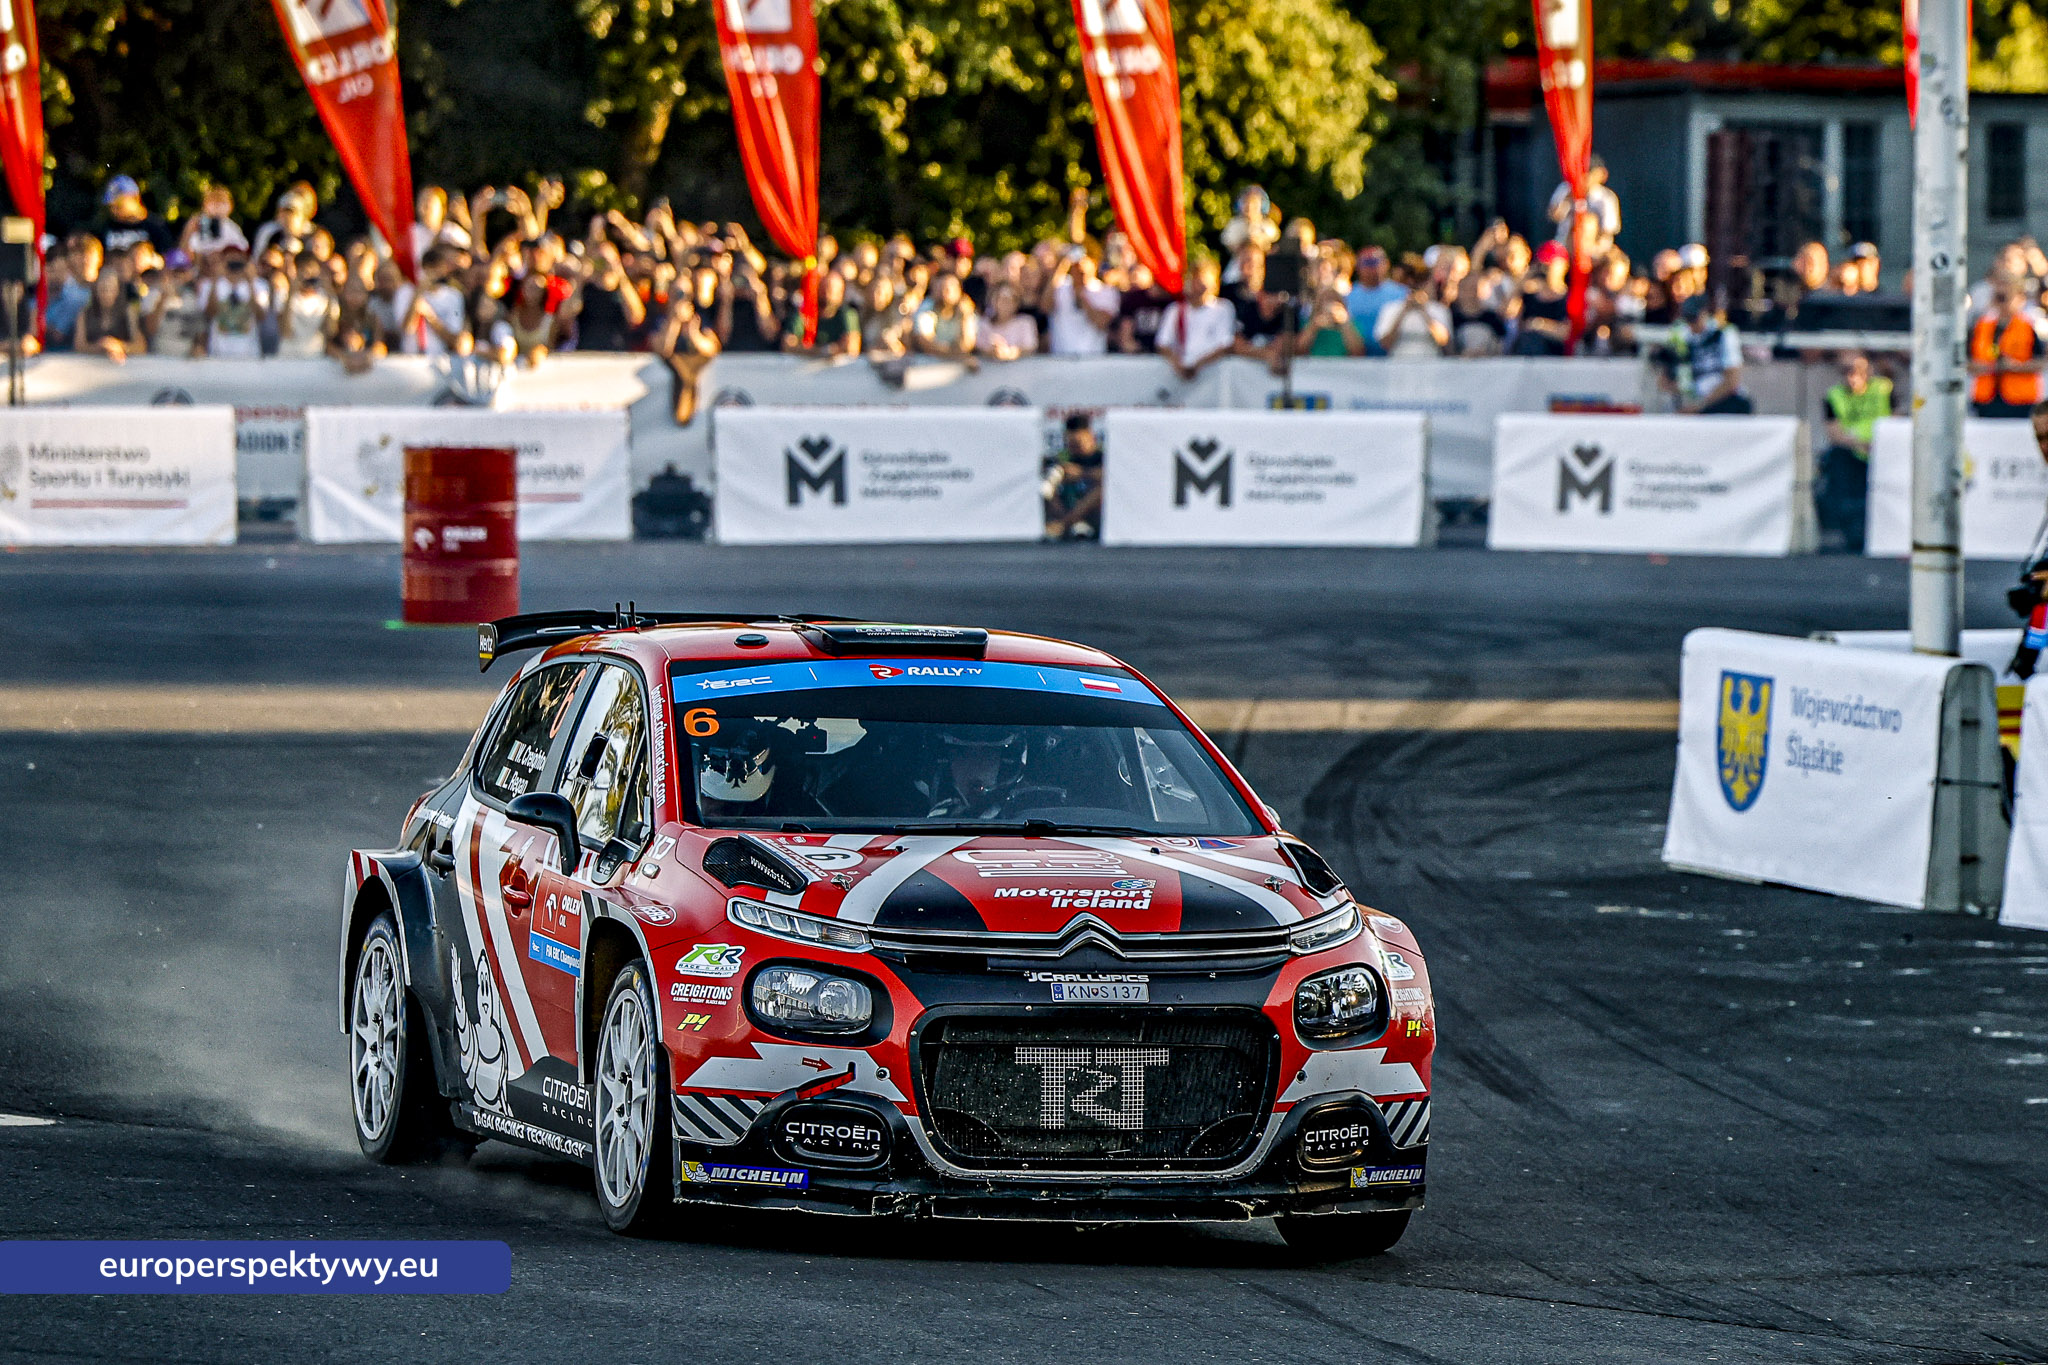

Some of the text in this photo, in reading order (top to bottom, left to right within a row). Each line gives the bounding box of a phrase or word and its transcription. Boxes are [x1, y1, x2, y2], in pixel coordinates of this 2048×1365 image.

[480, 634, 492, 652] Hertz
[549, 668, 588, 739] 6
[1790, 686, 1901, 734] Województwo
[683, 707, 720, 737] 6
[1785, 729, 1844, 778] Śląskie
[993, 886, 1153, 898] Motorsport
[561, 894, 582, 917] ORLEN
[1051, 896, 1152, 910] Ireland
[558, 913, 567, 928] OIL
[670, 982, 734, 1001] CREIGHTONS
[1067, 985, 1142, 999] KN S137
[677, 1013, 712, 1031] P1
[1406, 1020, 1422, 1037] P1
[542, 1102, 593, 1128] RACING
[472, 1110, 495, 1131] TAGAI
[526, 1126, 587, 1159] TECHNOLOGY
[785, 1122, 881, 1142] CITROËN
[1305, 1124, 1370, 1143] CITROËN
[785, 1135, 881, 1150] RACING
[1305, 1139, 1370, 1152] RACING
[711, 1167, 805, 1184] MICHELIN
[1368, 1168, 1423, 1182] MICHELIN
